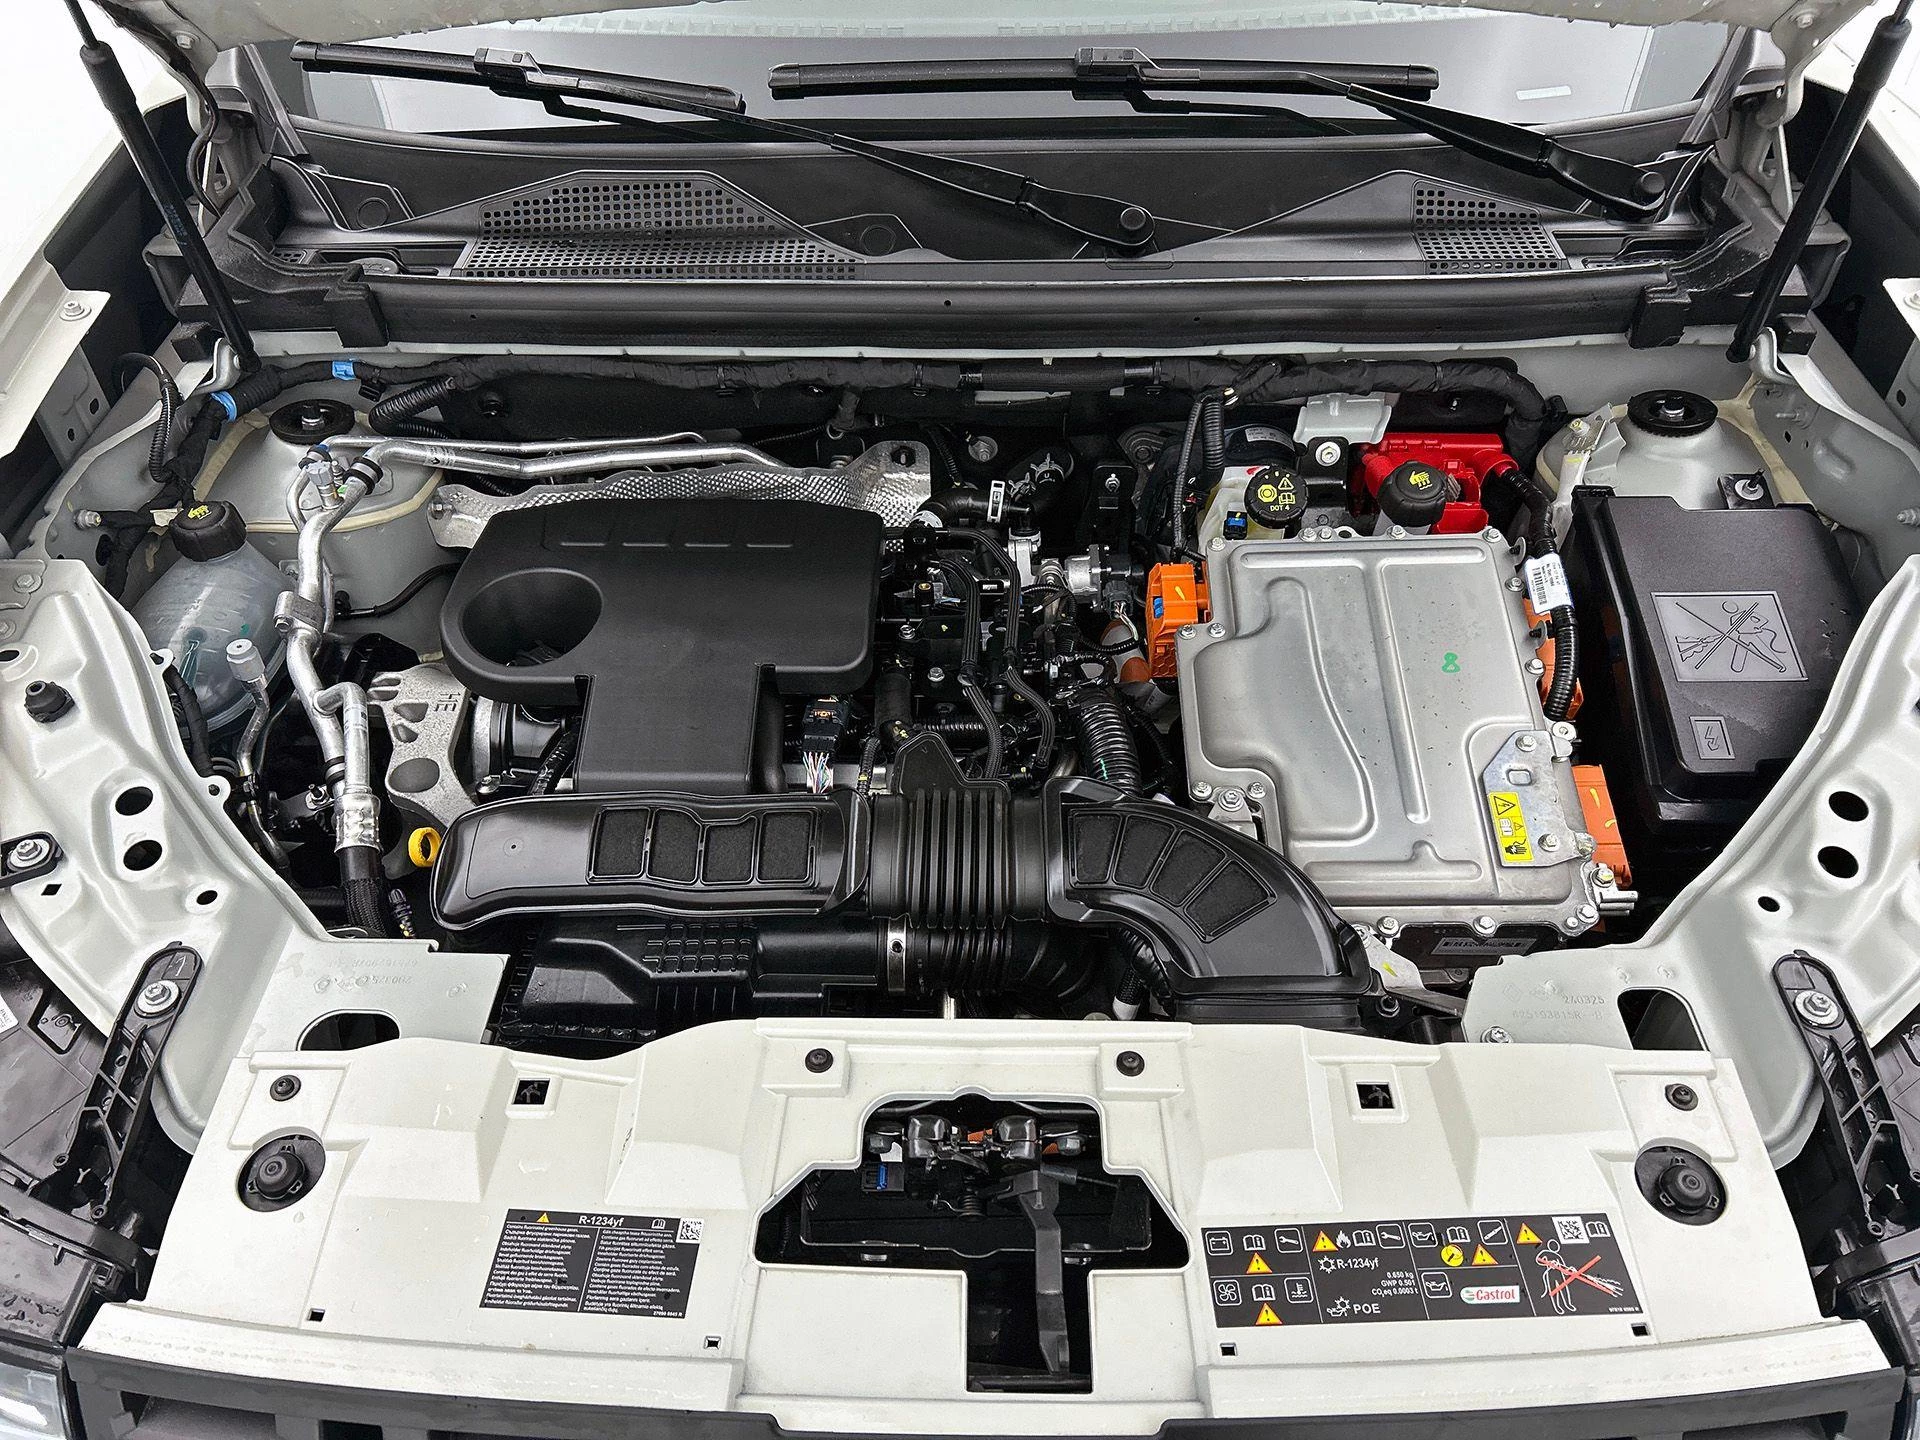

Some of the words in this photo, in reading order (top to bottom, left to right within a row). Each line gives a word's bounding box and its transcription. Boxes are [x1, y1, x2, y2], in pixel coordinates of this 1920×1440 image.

[1270, 504, 1284, 512] DOT
[578, 1215, 625, 1228] R-1234yf
[1337, 1257, 1379, 1271] R-1234yf
[1404, 1271, 1414, 1280] kg
[1380, 1279, 1397, 1287] GWP
[1398, 1279, 1416, 1287] 0.501
[1476, 1289, 1516, 1301] Castrol
[1353, 1303, 1381, 1315] POE
